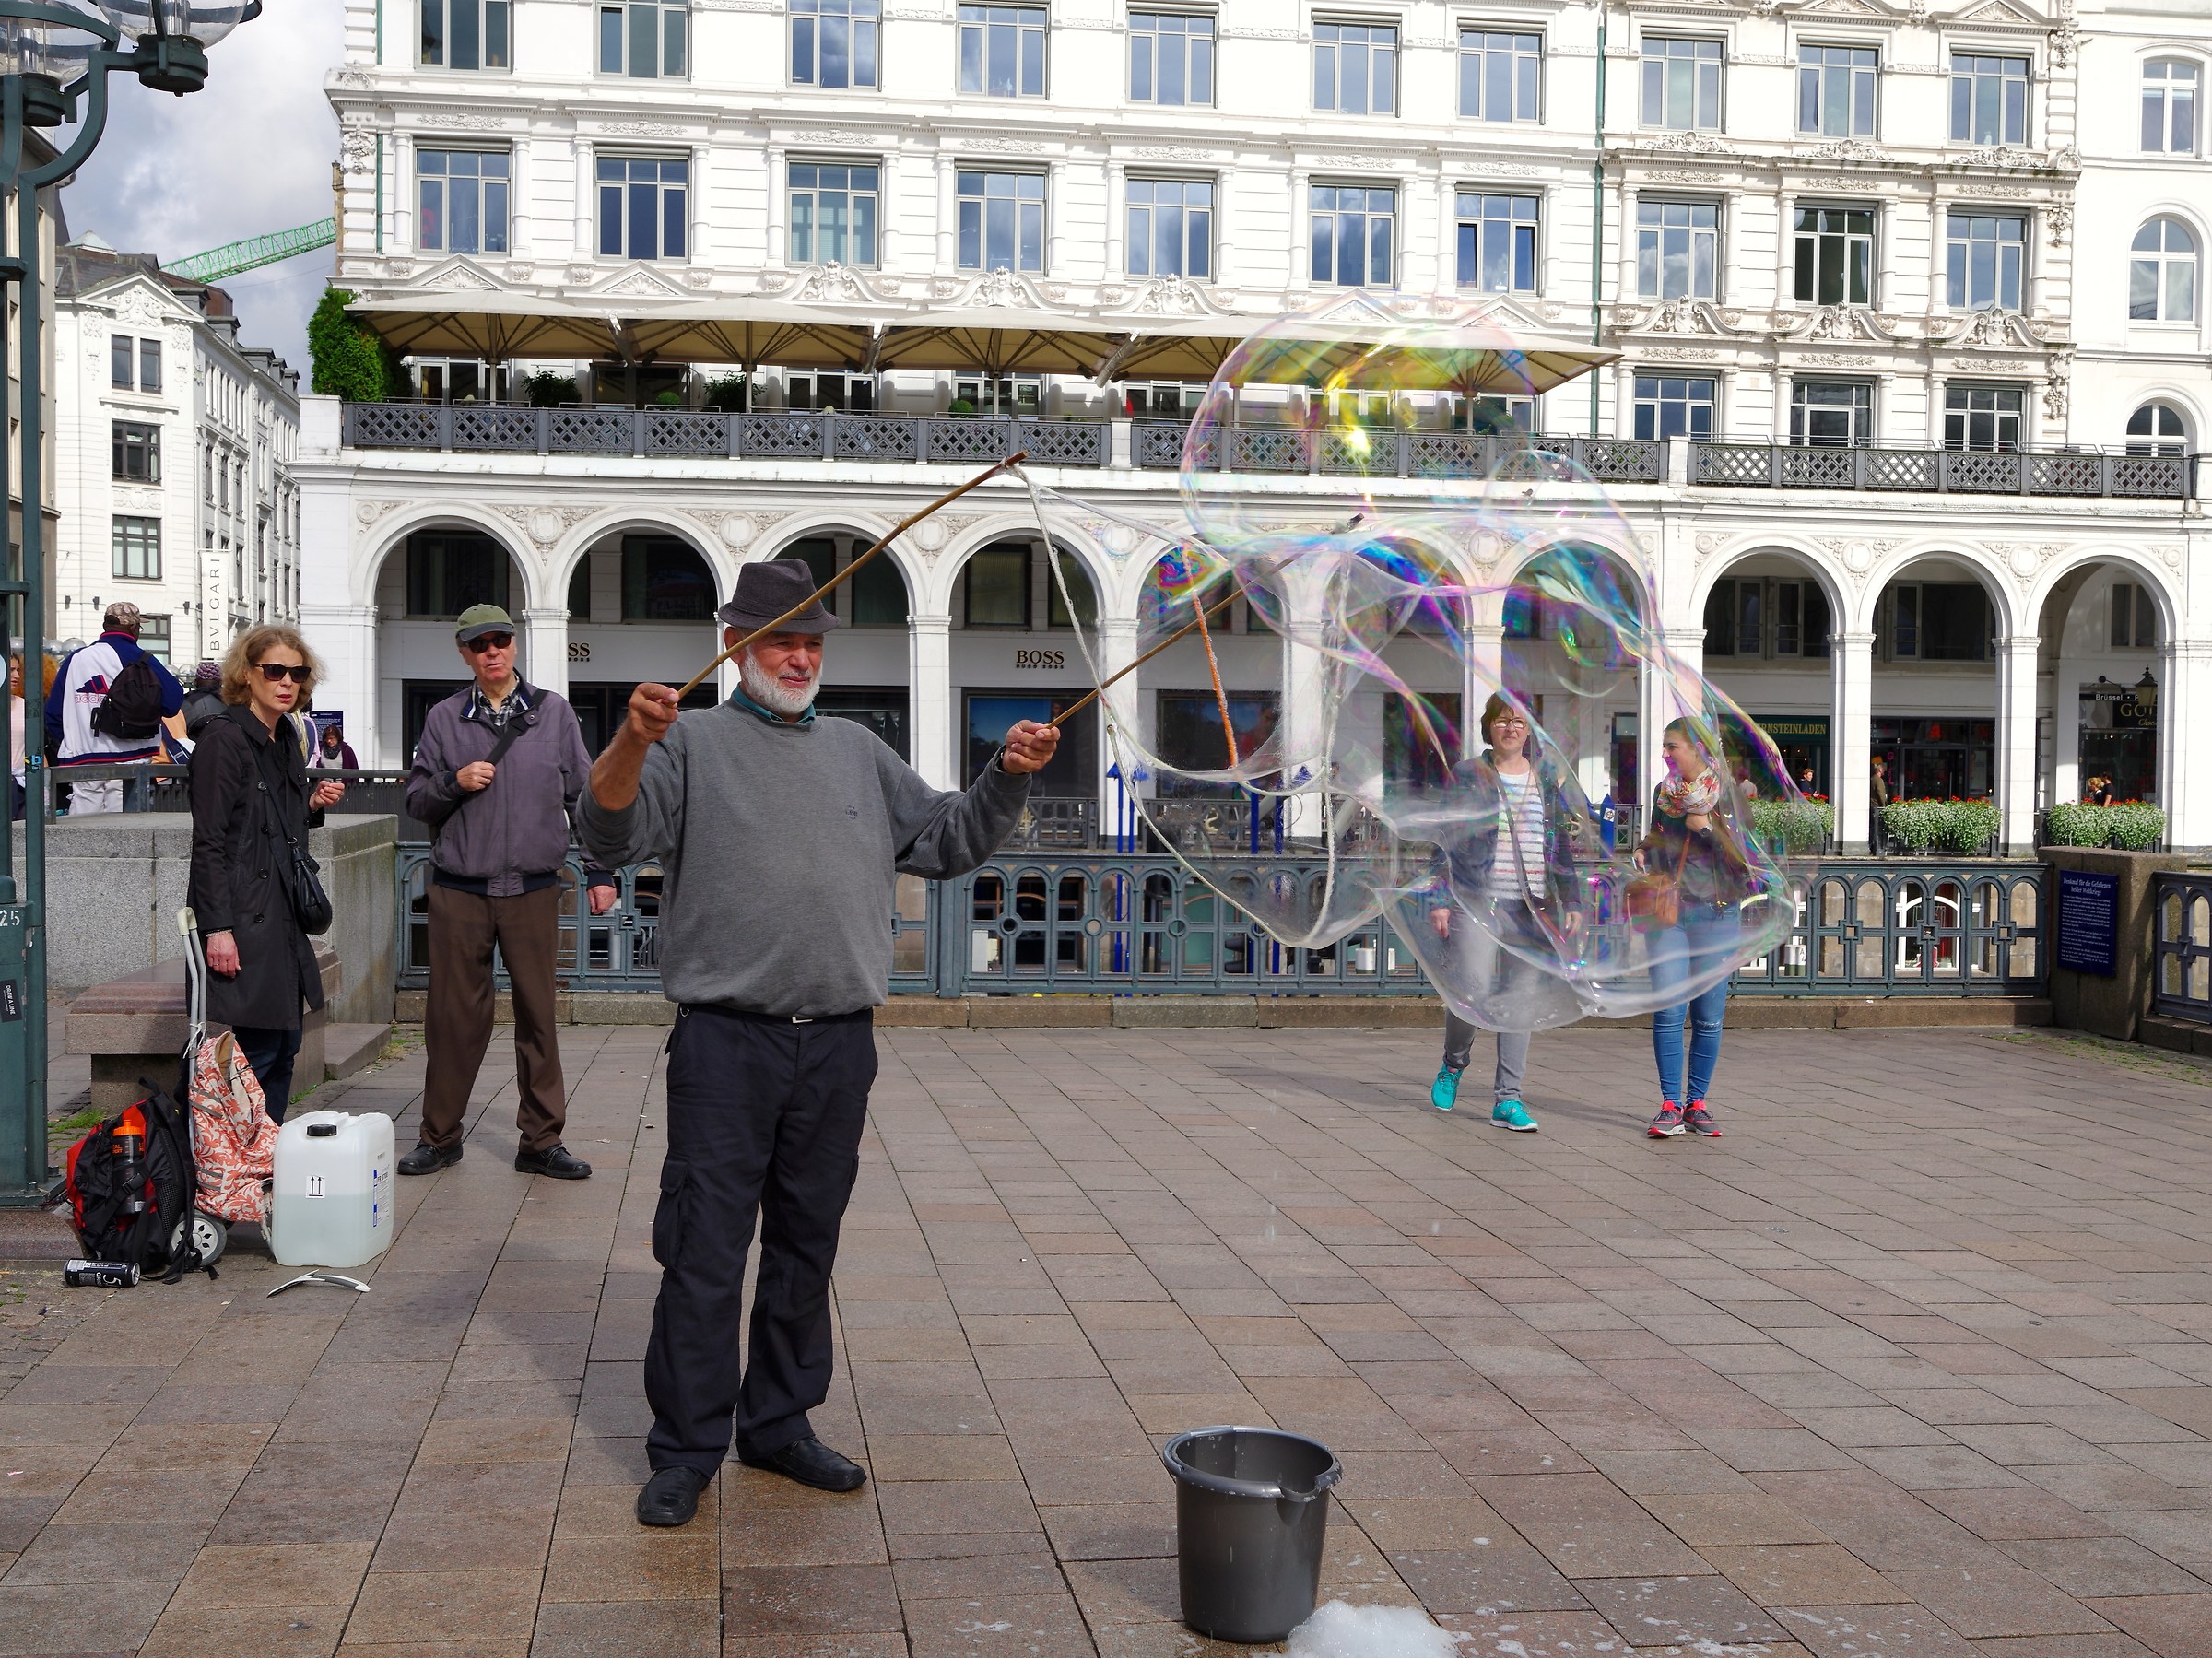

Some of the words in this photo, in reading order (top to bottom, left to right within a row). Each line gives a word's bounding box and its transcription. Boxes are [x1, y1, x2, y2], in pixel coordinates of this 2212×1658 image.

[209, 559, 220, 651] BVLGARI
[568, 642, 591, 657] SS
[1016, 650, 1065, 664] BOSS
[1757, 723, 1827, 735] RNSTEINLADEN
